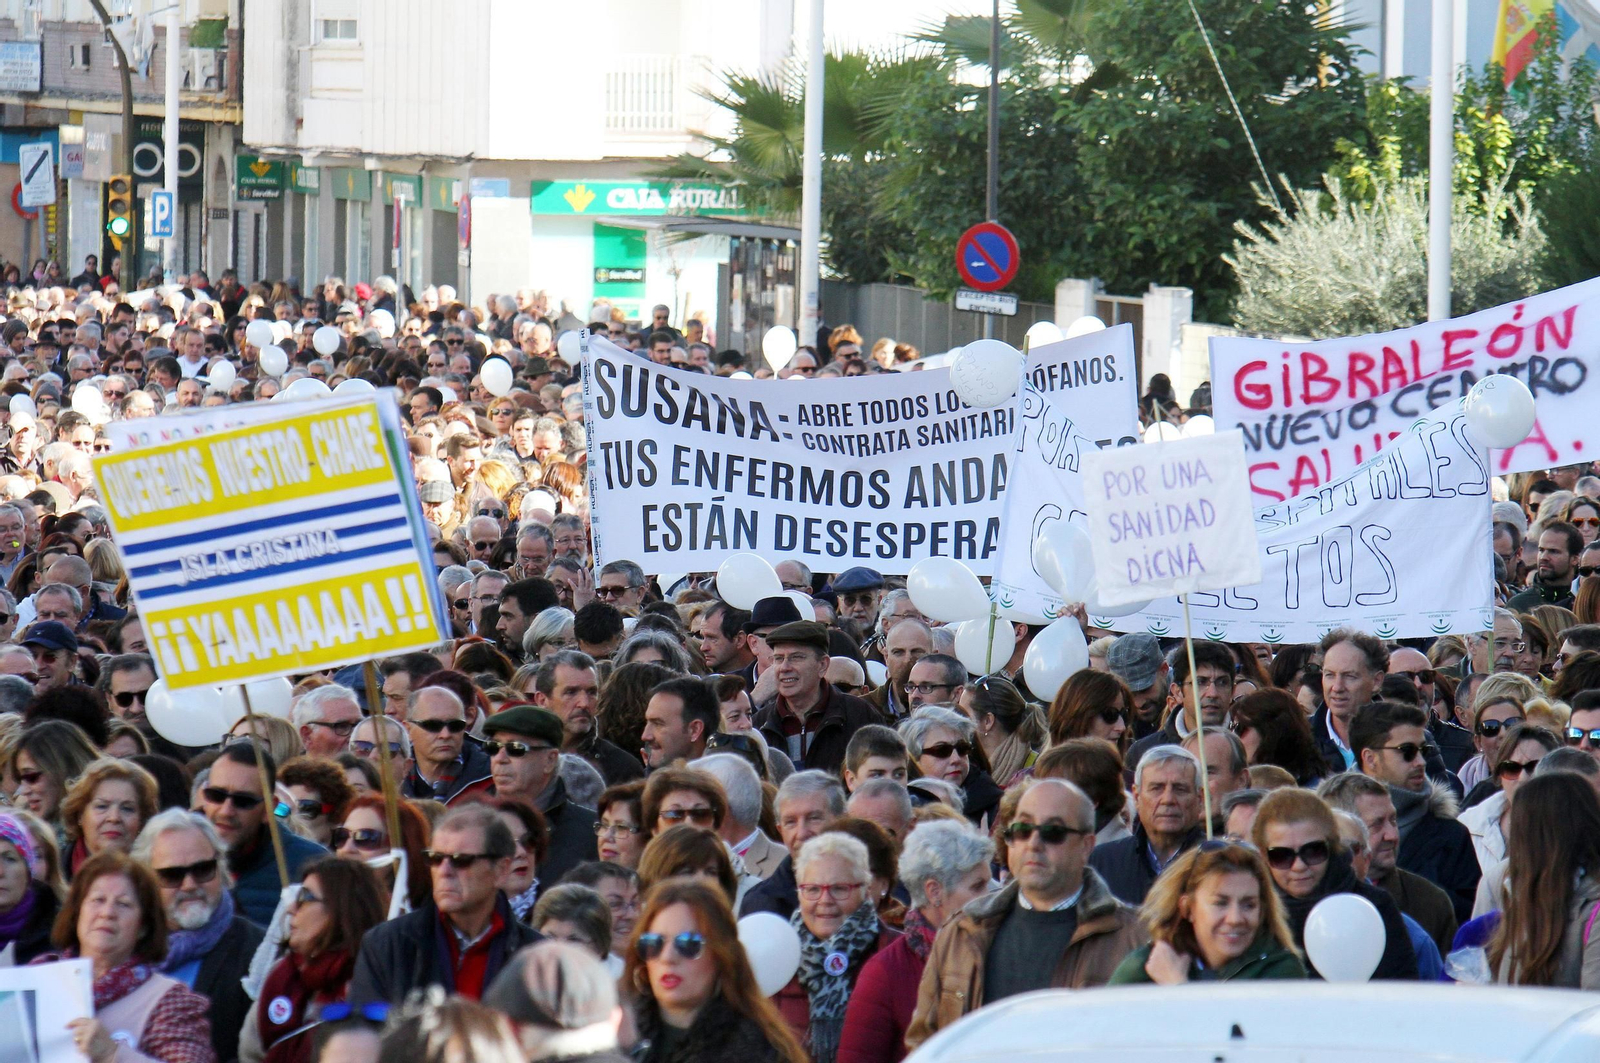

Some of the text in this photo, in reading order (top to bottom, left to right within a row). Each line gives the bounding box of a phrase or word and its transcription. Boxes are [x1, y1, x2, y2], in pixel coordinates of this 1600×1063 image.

[155, 195, 169, 233] P
[606, 188, 746, 210] CAJA RURAL
[798, 401, 860, 428] ABRE
[858, 394, 929, 426] TODOS
[1026, 354, 1124, 394] ÓFANOS.
[802, 428, 911, 458] CONTRATA
[1236, 399, 1379, 452] NUEVO
[101, 411, 386, 520] QUEREMOS NUESTRO CHARE
[600, 439, 658, 491] TUS
[671, 443, 891, 510] ENFERMOS
[1102, 458, 1213, 501] POR UNA
[642, 495, 759, 553] ESTÁN
[178, 528, 342, 582] ISLA CRISTINA
